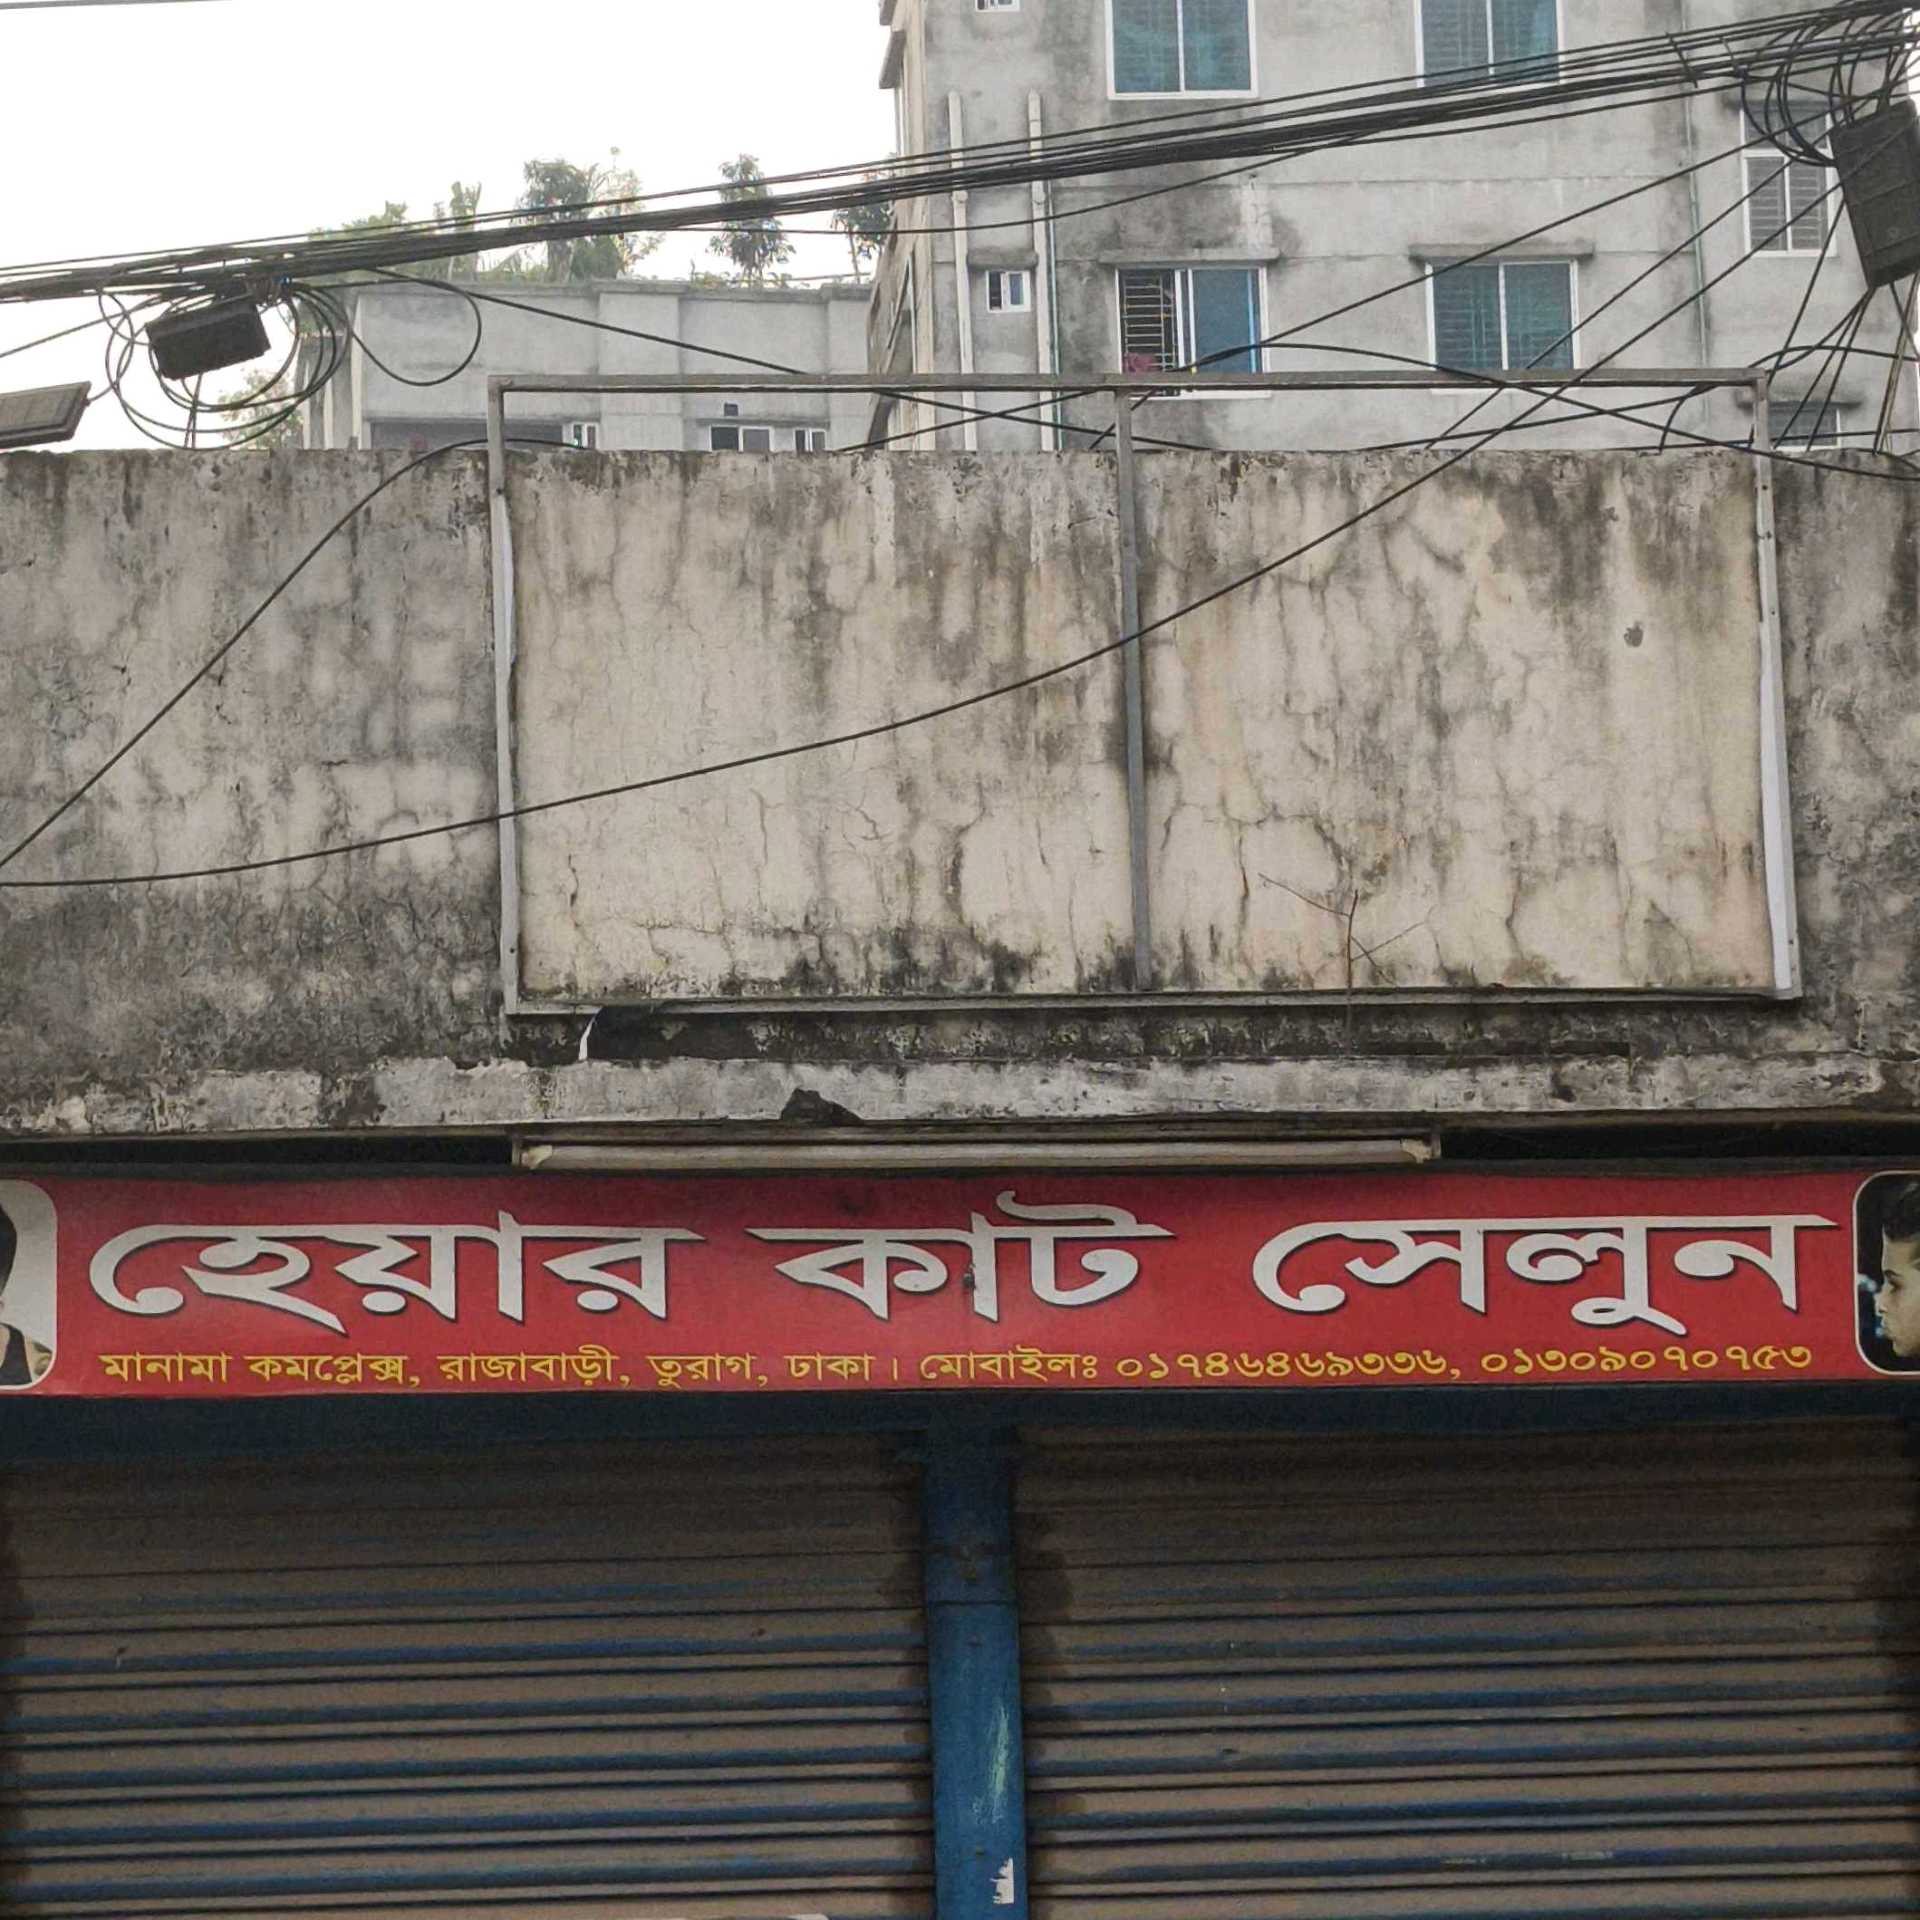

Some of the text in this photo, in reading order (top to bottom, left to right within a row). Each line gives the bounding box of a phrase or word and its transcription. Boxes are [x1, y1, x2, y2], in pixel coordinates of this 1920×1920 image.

[89, 1190, 1838, 1335] হেয়ার কাট সেলুন
[98, 1351, 233, 1382] মানামা
[646, 1352, 768, 1388] তুরাগ,
